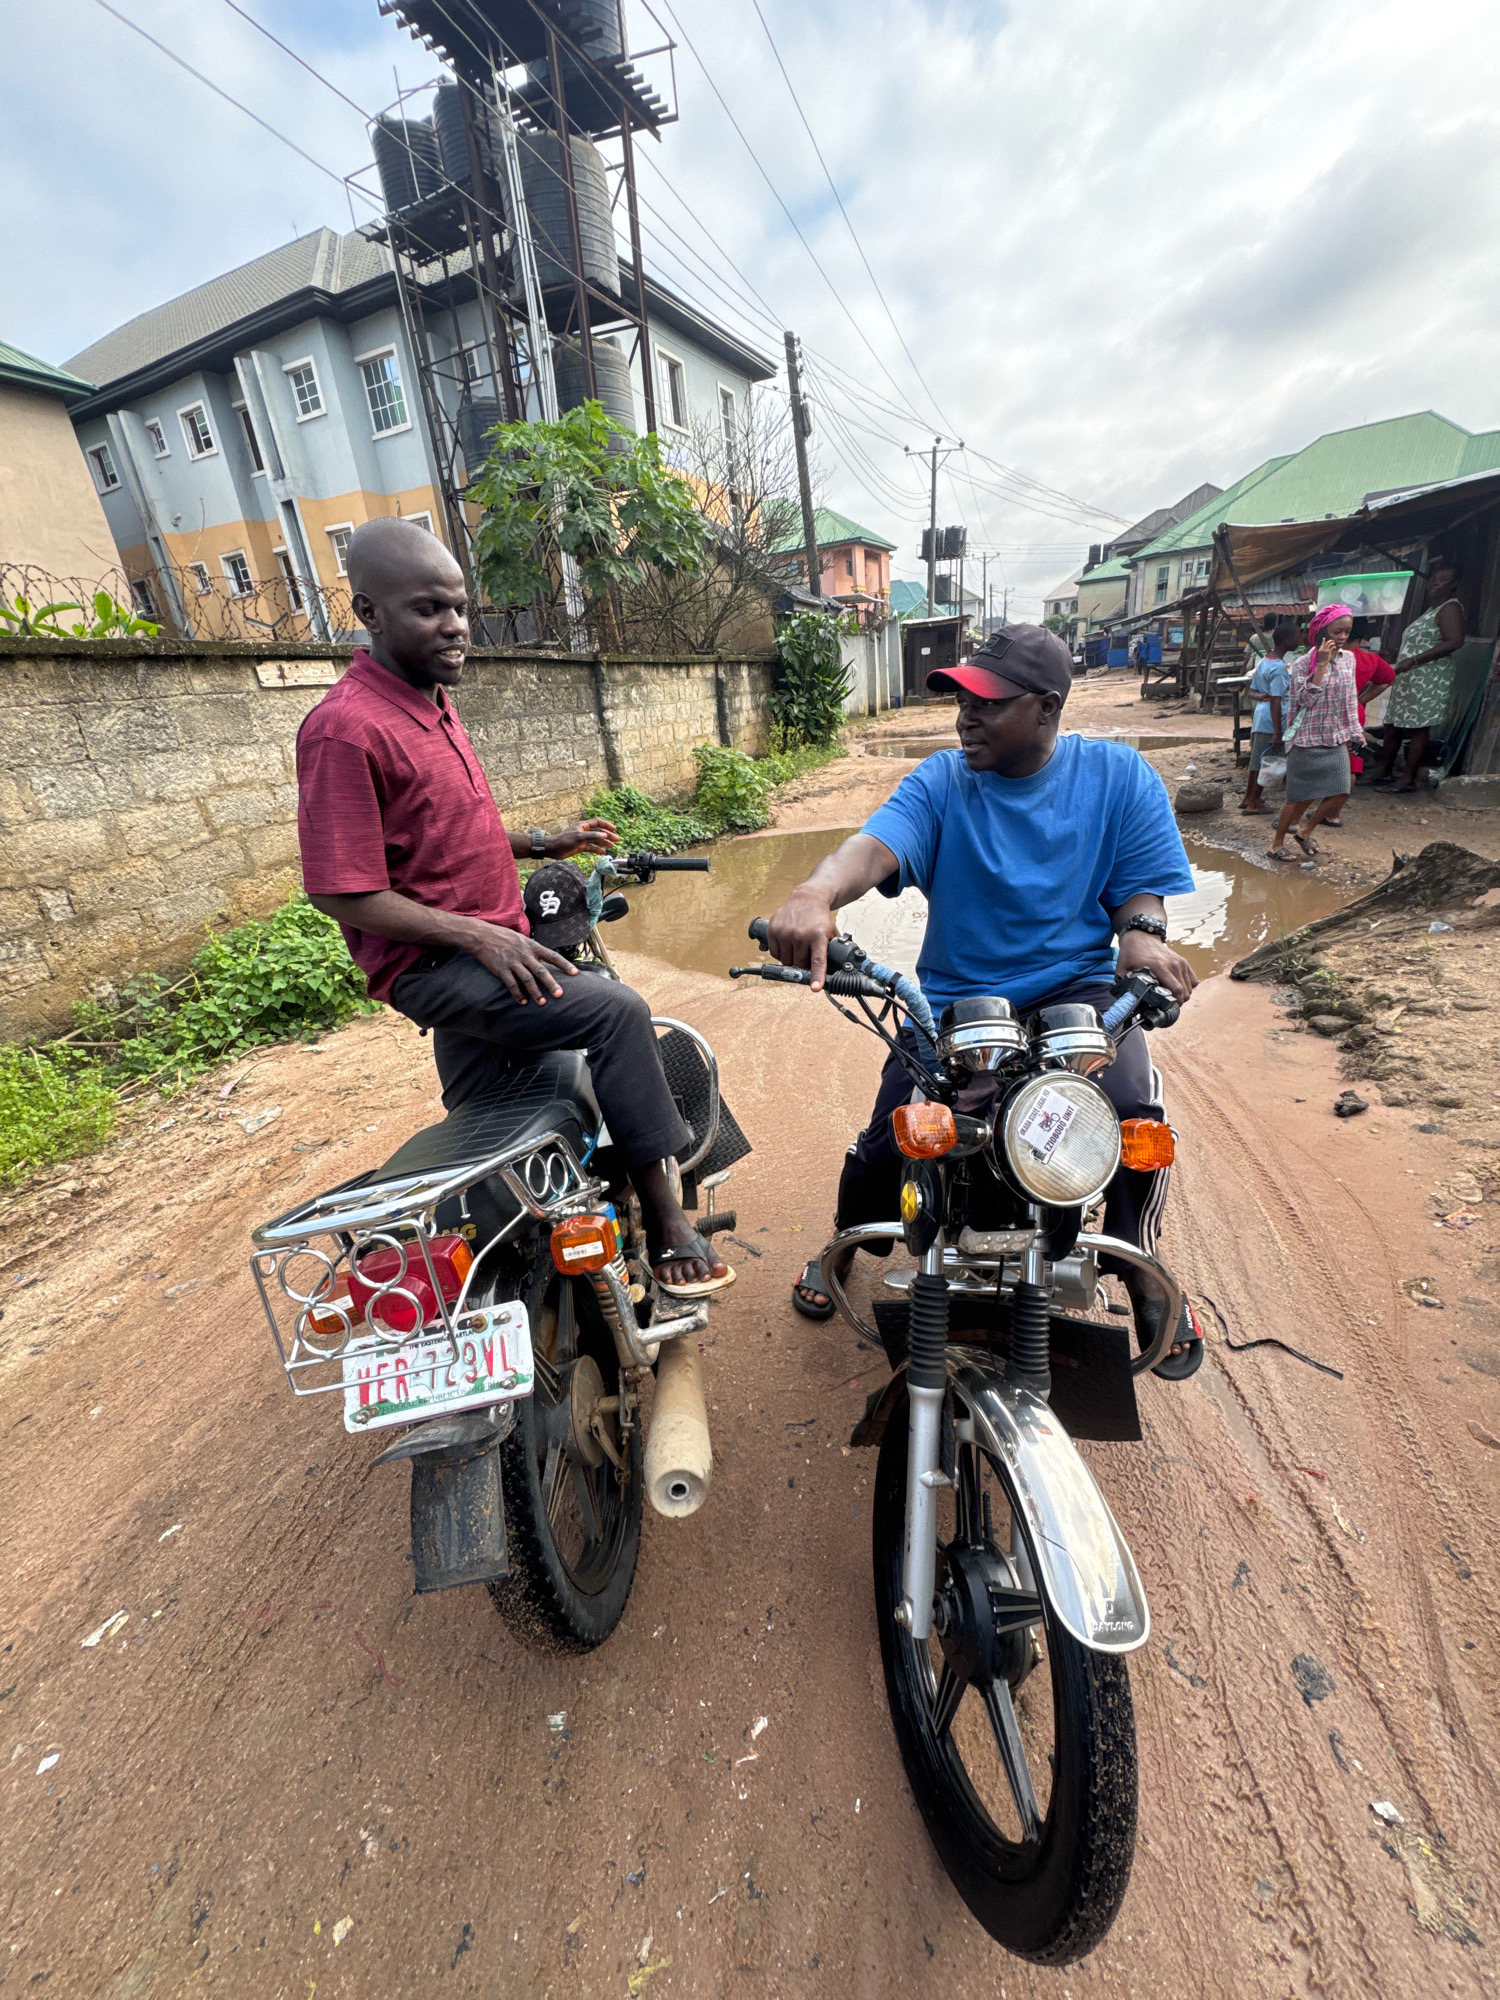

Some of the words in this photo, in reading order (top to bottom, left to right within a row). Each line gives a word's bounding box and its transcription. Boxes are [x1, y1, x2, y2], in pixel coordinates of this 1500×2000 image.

[539, 890, 561, 918] S
[1020, 1120, 1032, 1136] OKADA
[1029, 1107, 1040, 1122] STATE
[1036, 1097, 1047, 1110] LEGAL
[1042, 1089, 1051, 1098] FEE
[1043, 1120, 1067, 1152] EZIOBODO
[1062, 1105, 1075, 1122] UNIT
[382, 1399, 418, 1414] FEDERAL
